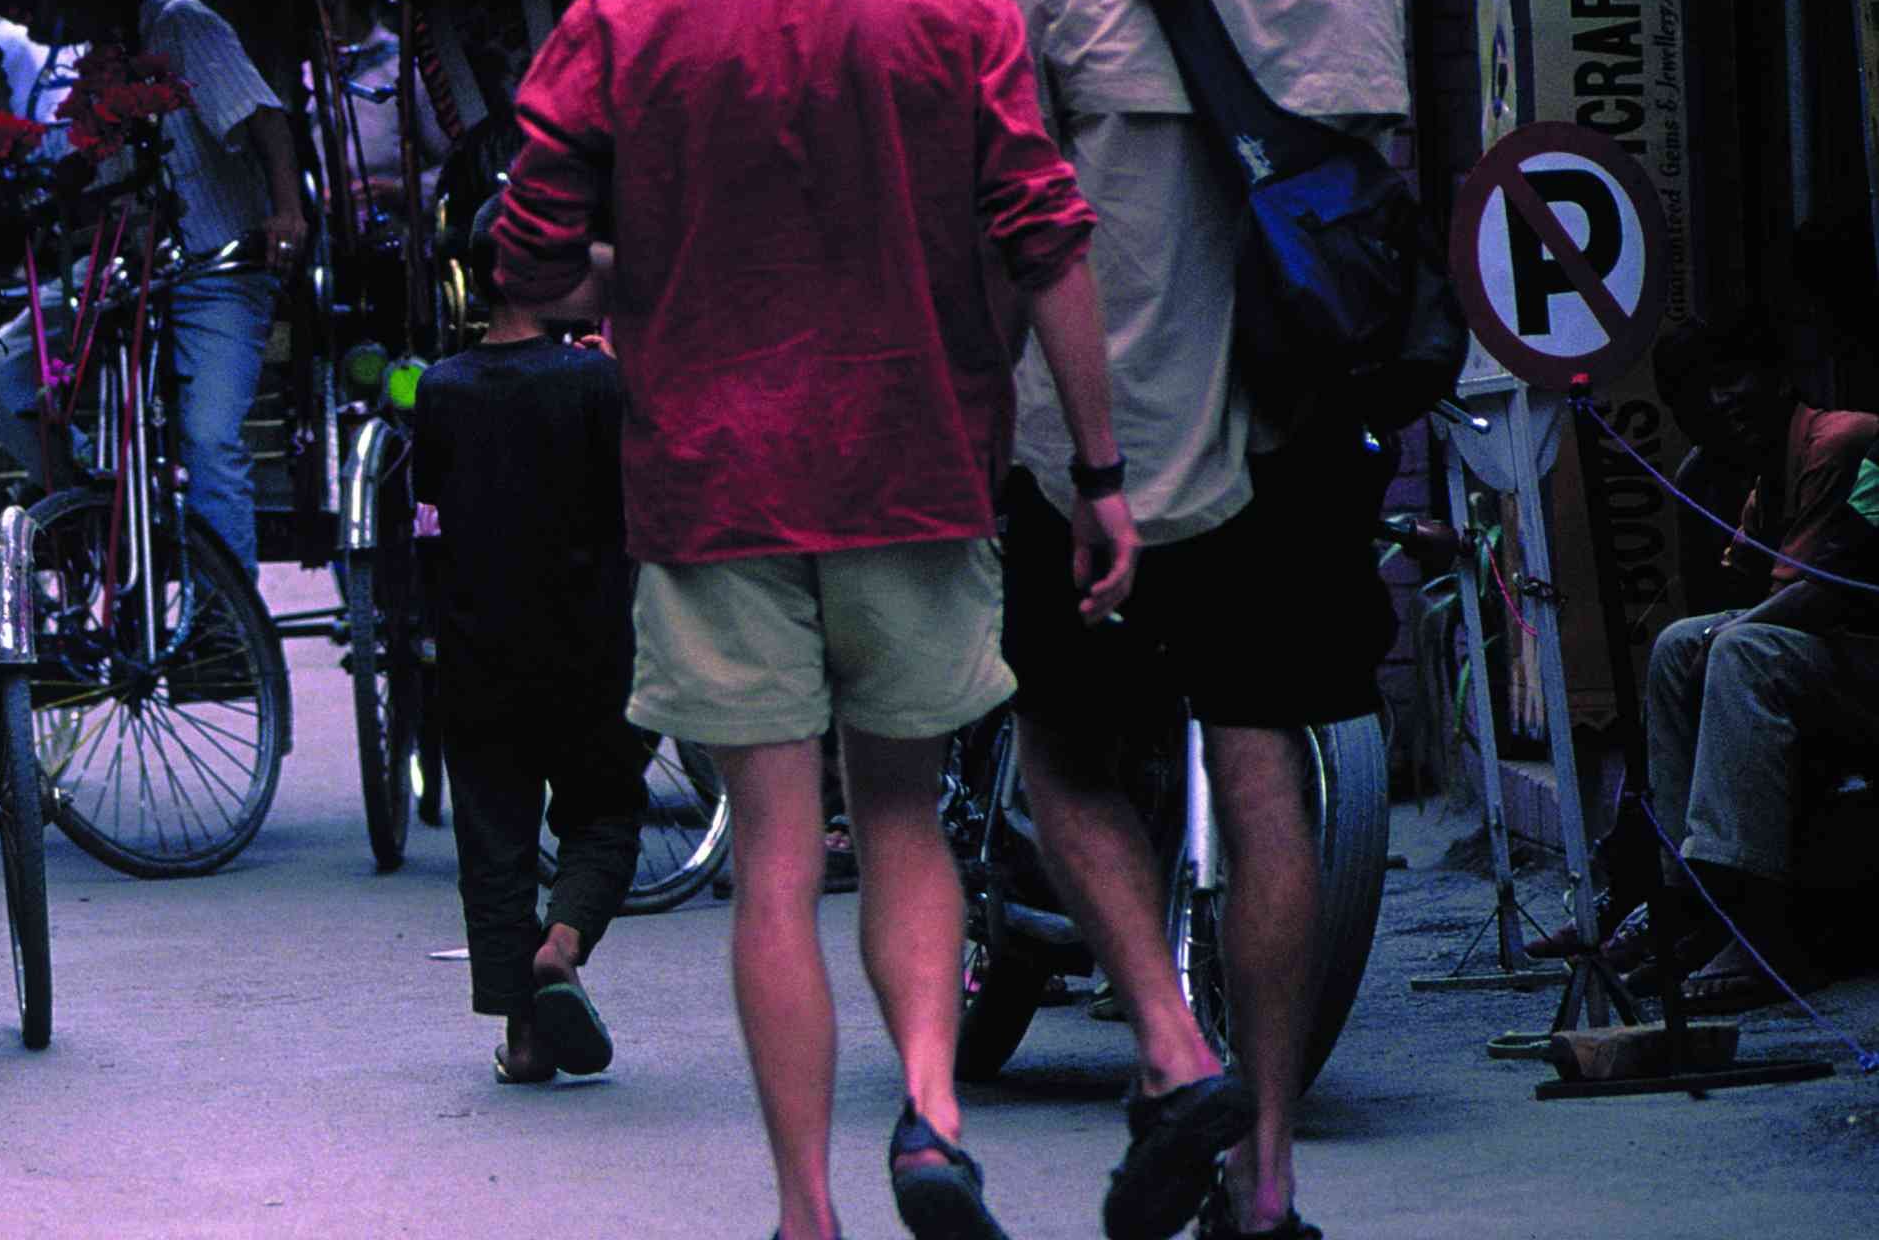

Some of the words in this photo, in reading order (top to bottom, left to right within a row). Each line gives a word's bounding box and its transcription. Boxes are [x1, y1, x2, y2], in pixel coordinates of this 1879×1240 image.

[1652, 7, 1680, 91] Jewellery
[1654, 95, 1676, 112] &
[1658, 120, 1682, 178] Gems
